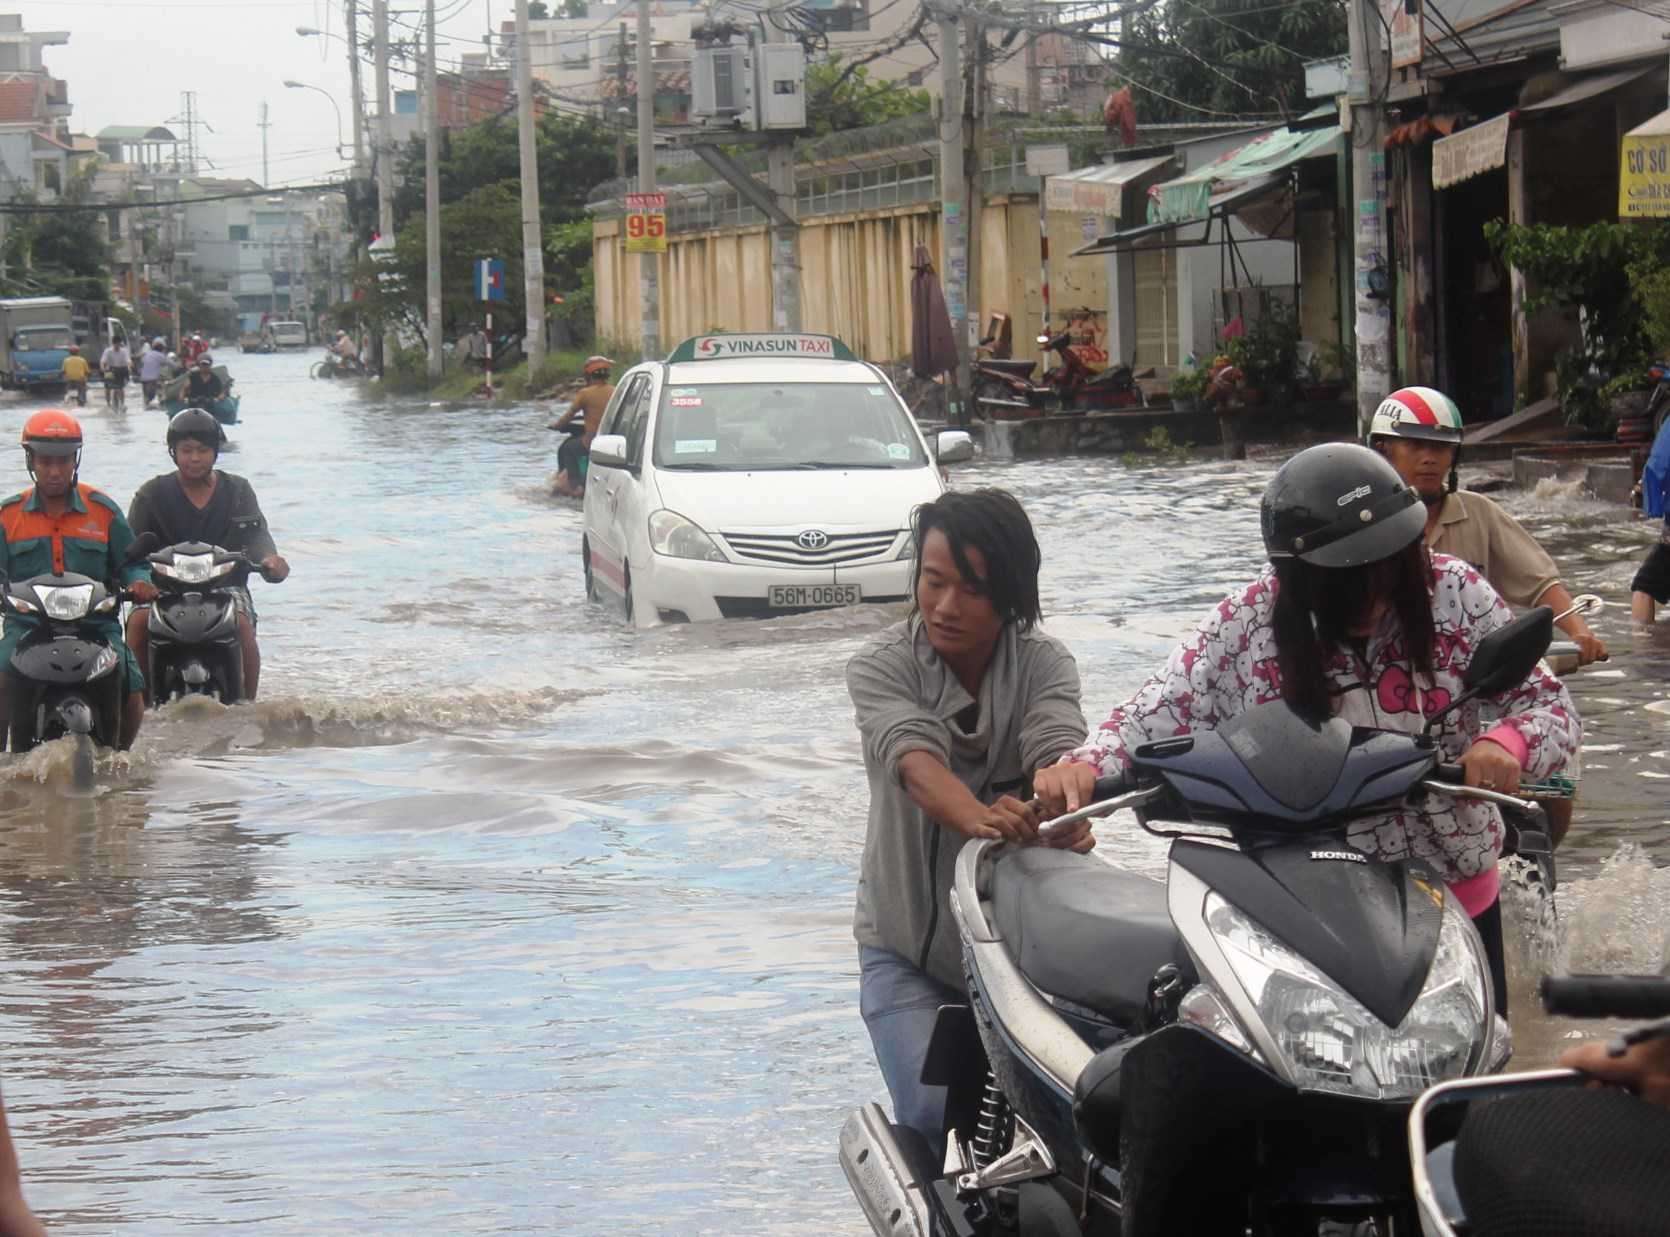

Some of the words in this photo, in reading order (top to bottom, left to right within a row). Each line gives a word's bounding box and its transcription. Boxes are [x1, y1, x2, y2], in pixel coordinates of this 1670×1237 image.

[627, 215, 665, 238] 95
[728, 340, 797, 353] VINASUN
[799, 339, 830, 353] TAXI
[1311, 851, 1367, 863] HONDA
